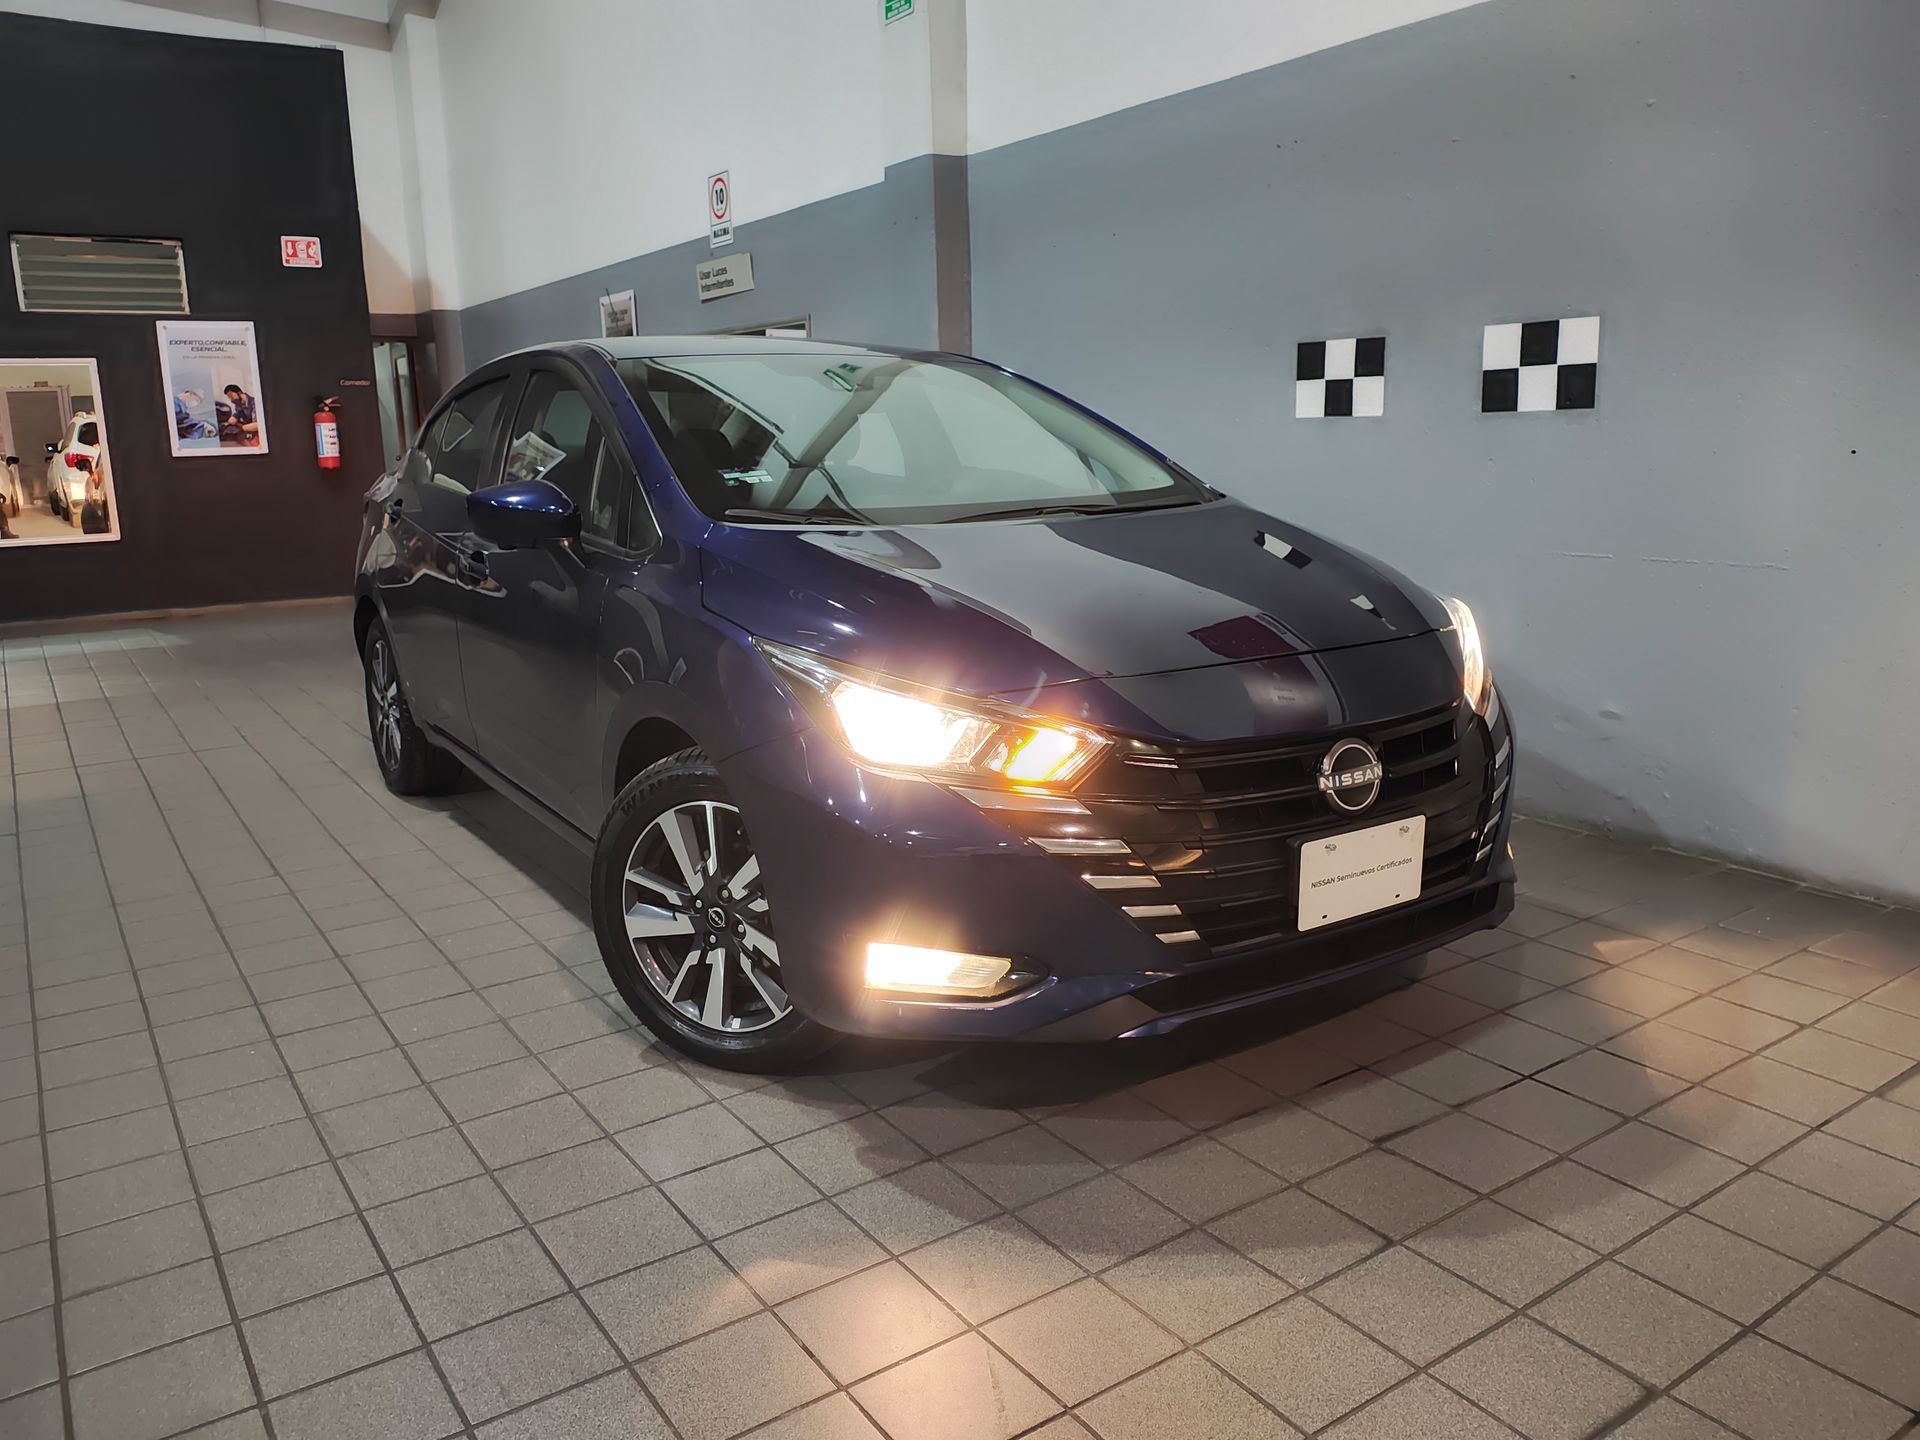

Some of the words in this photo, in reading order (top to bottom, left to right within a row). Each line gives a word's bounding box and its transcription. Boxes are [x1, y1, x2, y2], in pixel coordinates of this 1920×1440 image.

[715, 188, 725, 206] 10
[1319, 766, 1382, 788] NISSAN
[1311, 877, 1335, 888] NISSAN
[1336, 868, 1375, 882] Seminuevos
[1376, 857, 1413, 871] Certificados
